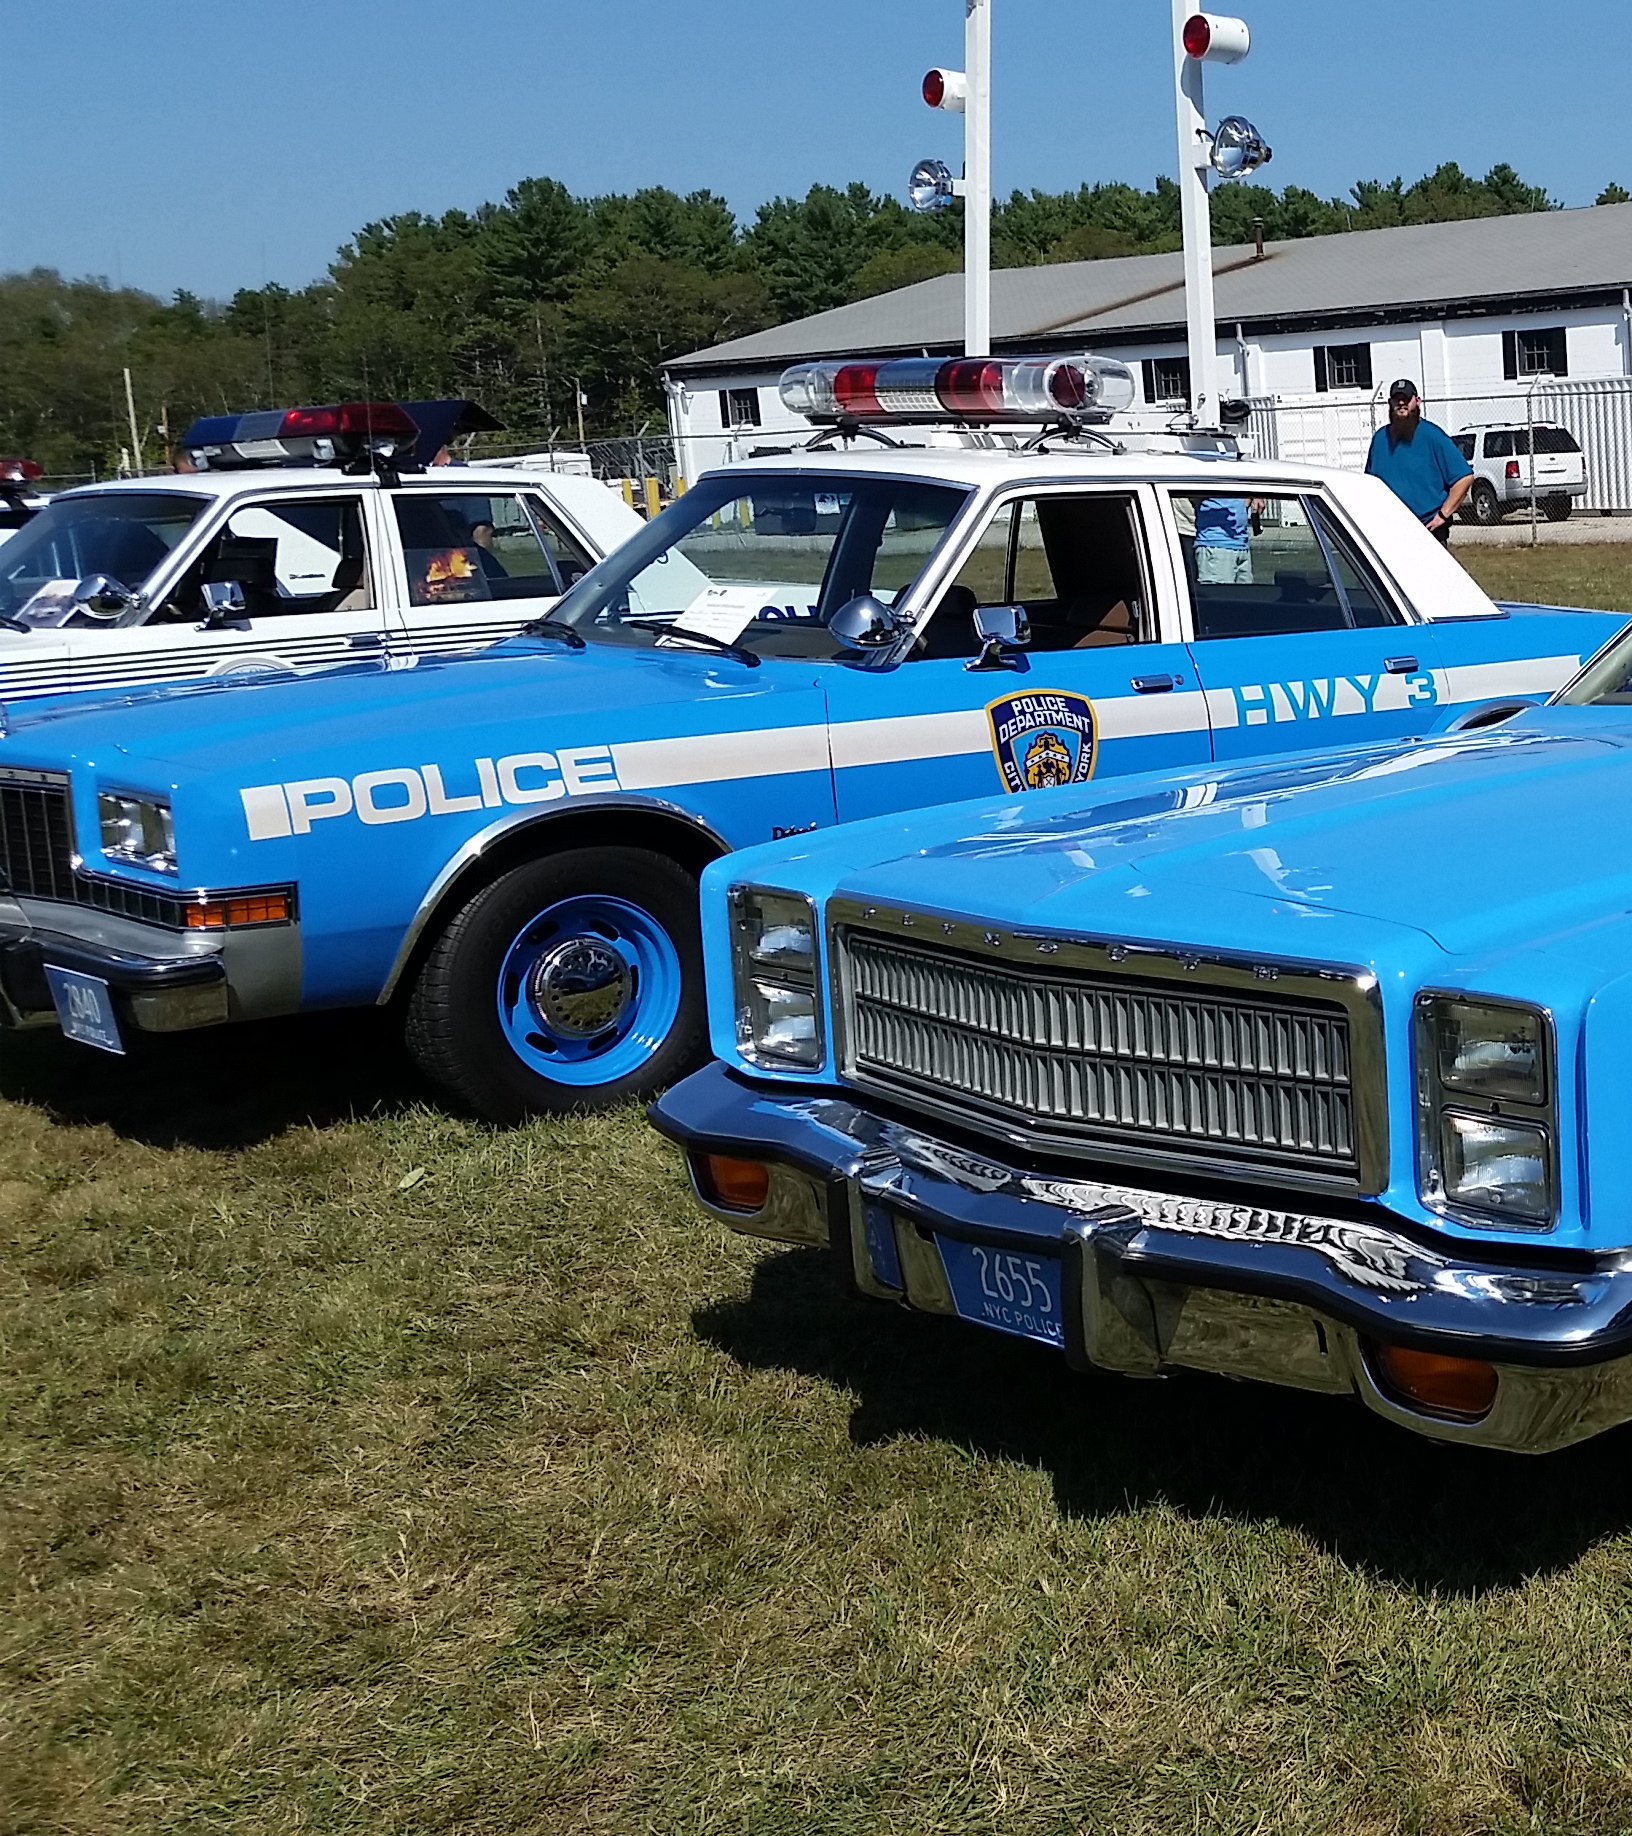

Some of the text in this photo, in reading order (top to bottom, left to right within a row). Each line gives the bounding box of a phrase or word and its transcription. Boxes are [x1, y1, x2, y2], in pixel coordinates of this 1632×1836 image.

[1011, 696, 1069, 717] POLICE
[1234, 669, 1438, 727] HWY 3
[998, 710, 1090, 745] DEPARTMENT
[1075, 742, 1092, 782] YORK
[286, 744, 621, 835] POLICE
[971, 1246, 1053, 1314] 2655
[983, 1301, 1064, 1340] NYC POLICE
